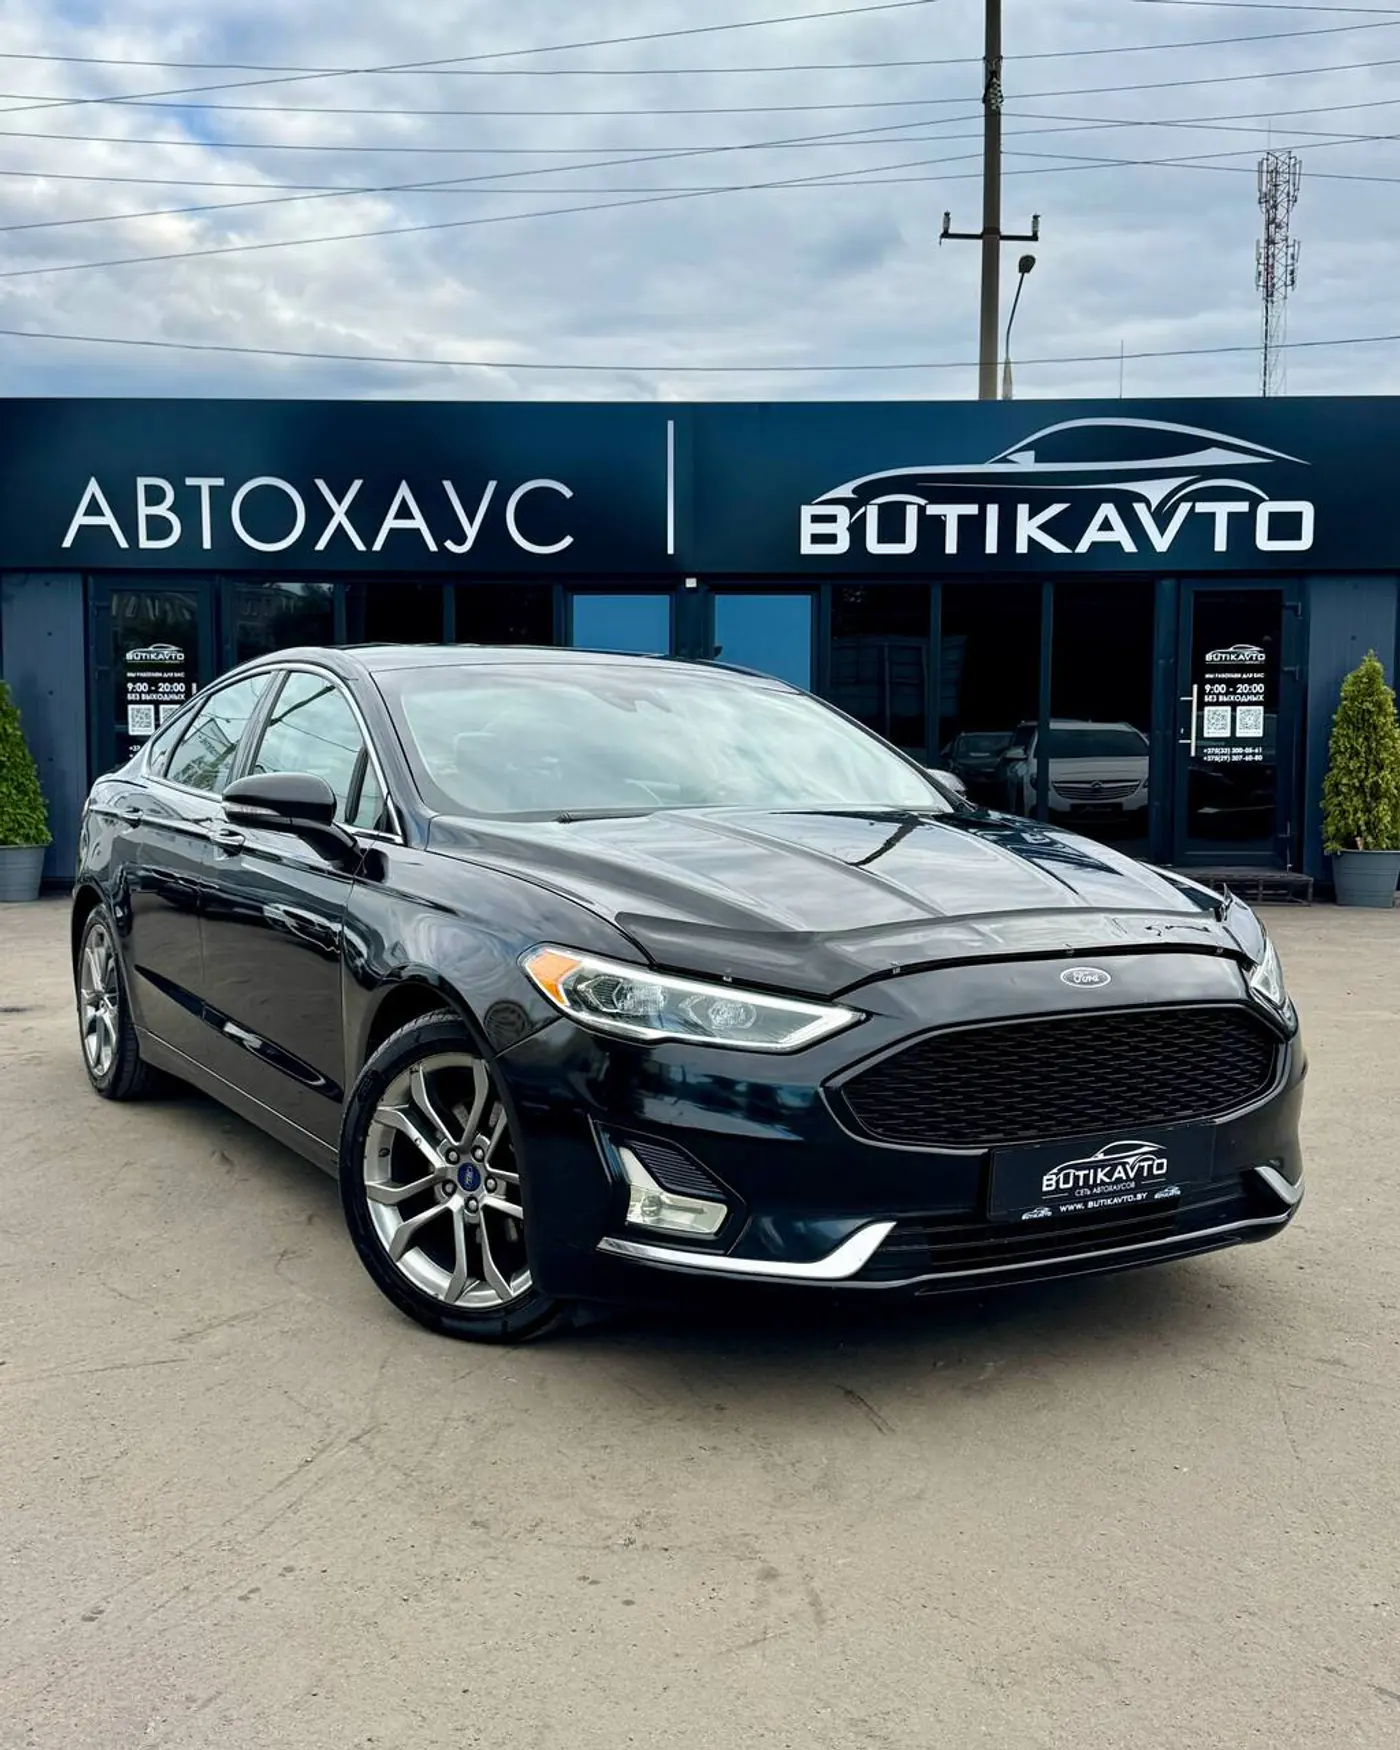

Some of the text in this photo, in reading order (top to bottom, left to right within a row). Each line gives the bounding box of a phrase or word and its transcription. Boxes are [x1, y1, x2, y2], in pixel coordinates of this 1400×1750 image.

[61, 476, 574, 555] АВТОХАУС
[800, 499, 1315, 555] BUTIKAVTO
[126, 652, 185, 660] BUTIKAVTO
[1205, 653, 1266, 661] BUTIKAVTO
[127, 682, 149, 692] 9:00
[157, 682, 186, 692] 20:00
[1204, 684, 1226, 693] 9:00
[1236, 683, 1265, 693] 20:00
[141, 693, 186, 701] ВЫХОДНЫХ
[1218, 694, 1265, 702] ВЫХОДНЫХ
[1073, 970, 1100, 983] Ford
[1042, 1158, 1168, 1192] BUTIKAVTO
[1074, 1188, 1091, 1197] СЕТЬ
[1059, 1203, 1085, 1213] WWW.
[1087, 1192, 1148, 1209] BUTIKAVTO.BY
